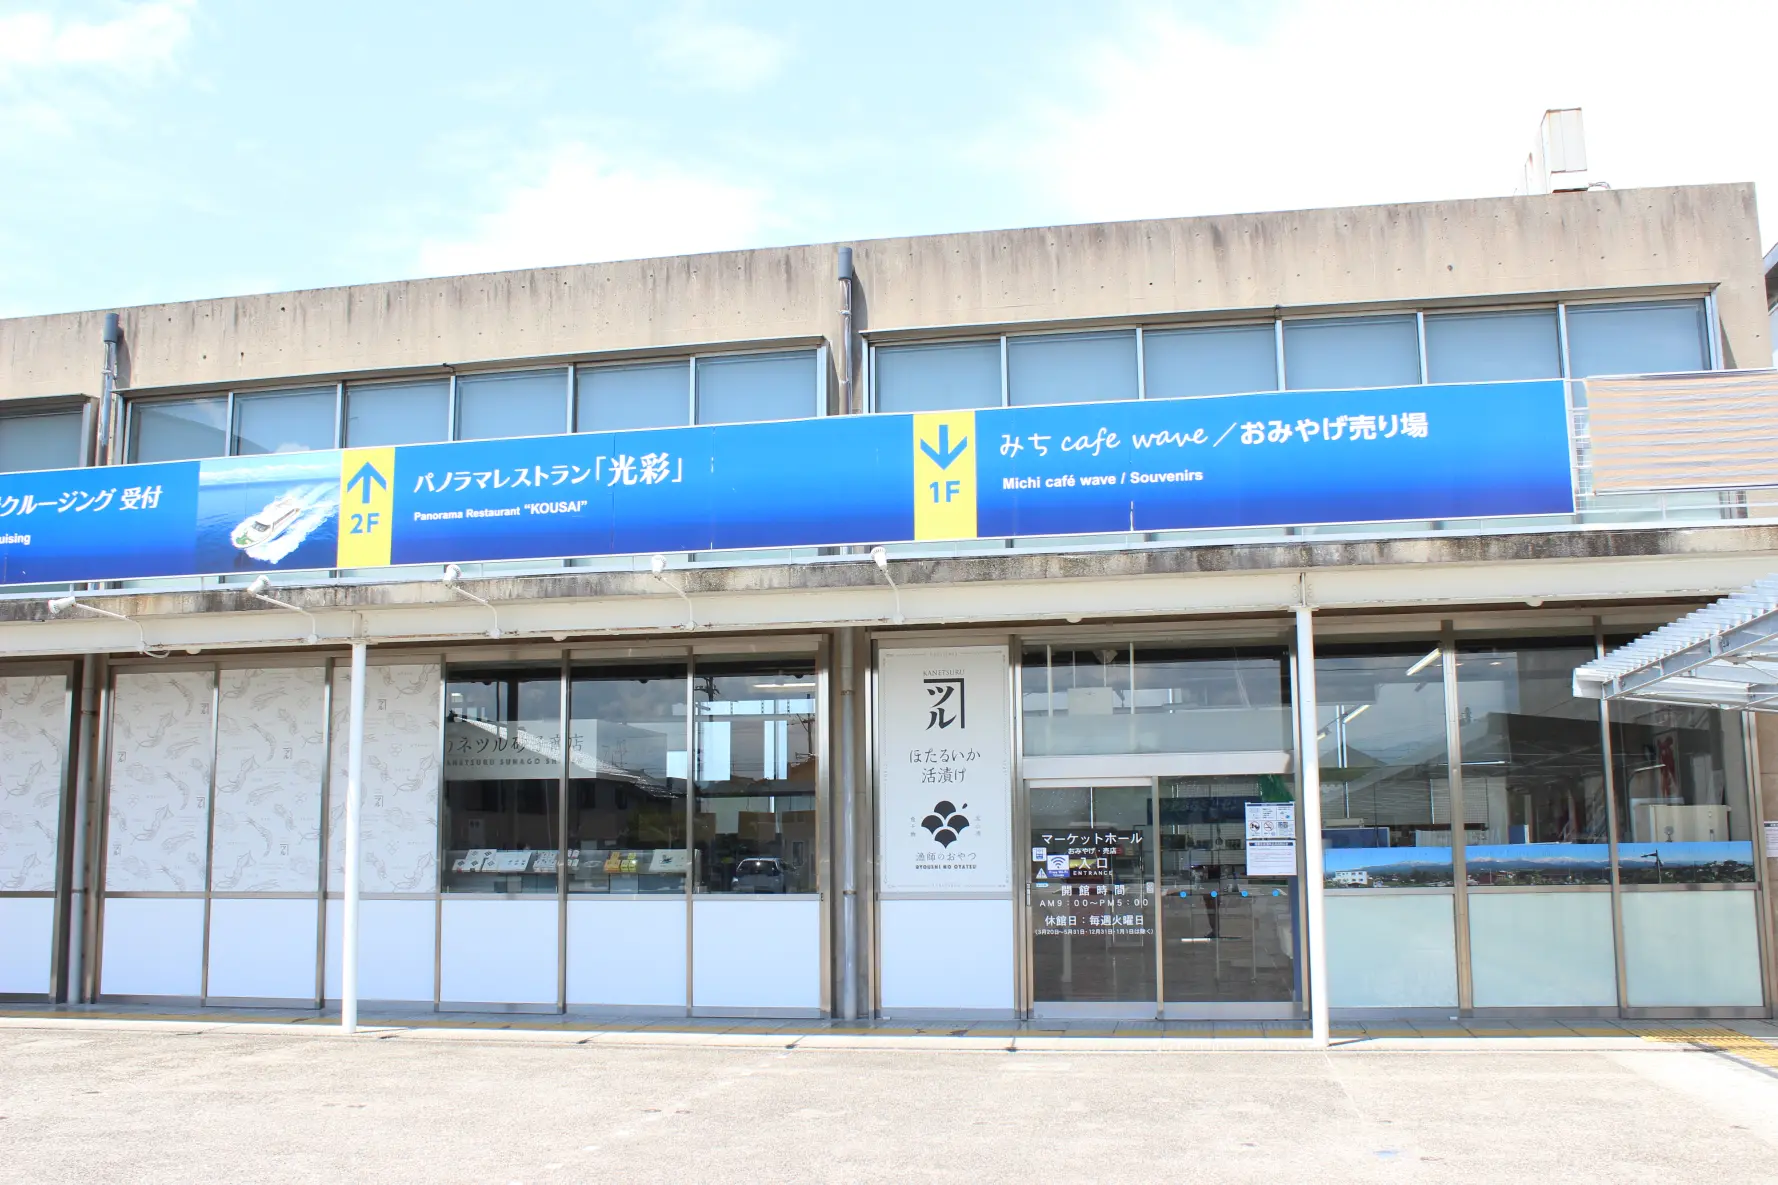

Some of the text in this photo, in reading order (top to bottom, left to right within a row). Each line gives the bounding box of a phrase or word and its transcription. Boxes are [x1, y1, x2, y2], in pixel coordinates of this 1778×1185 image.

[999, 432, 1052, 459] みち
[1061, 425, 1121, 457] cafe
[1132, 427, 1209, 451] wave
[1239, 412, 1429, 446] おみやげ売り場
[413, 452, 683, 494] パノラマレストラン「光彩」
[1002, 475, 1041, 490] Michi
[1045, 473, 1076, 488] café
[1080, 475, 1117, 487] wave
[1130, 469, 1204, 484] Souvenirs
[928, 480, 961, 503] 1F
[0, 485, 163, 517] クルージング 受付
[413, 500, 588, 522] Panorama Restaurant “KOUSAI”
[349, 512, 381, 534] 2F
[922, 669, 965, 677] KANETSURU
[909, 748, 981, 764] ほたるいか
[921, 767, 967, 784] 活漬け
[1041, 832, 1143, 845] マーケットホール
[915, 852, 977, 862] 漁師のおやつ
[1067, 847, 1117, 855] おみやげ・売店
[1079, 857, 1108, 869] 入口
[1061, 885, 1125, 896] 開館時間
[1044, 915, 1144, 926] 休館日：毎週火曜日
